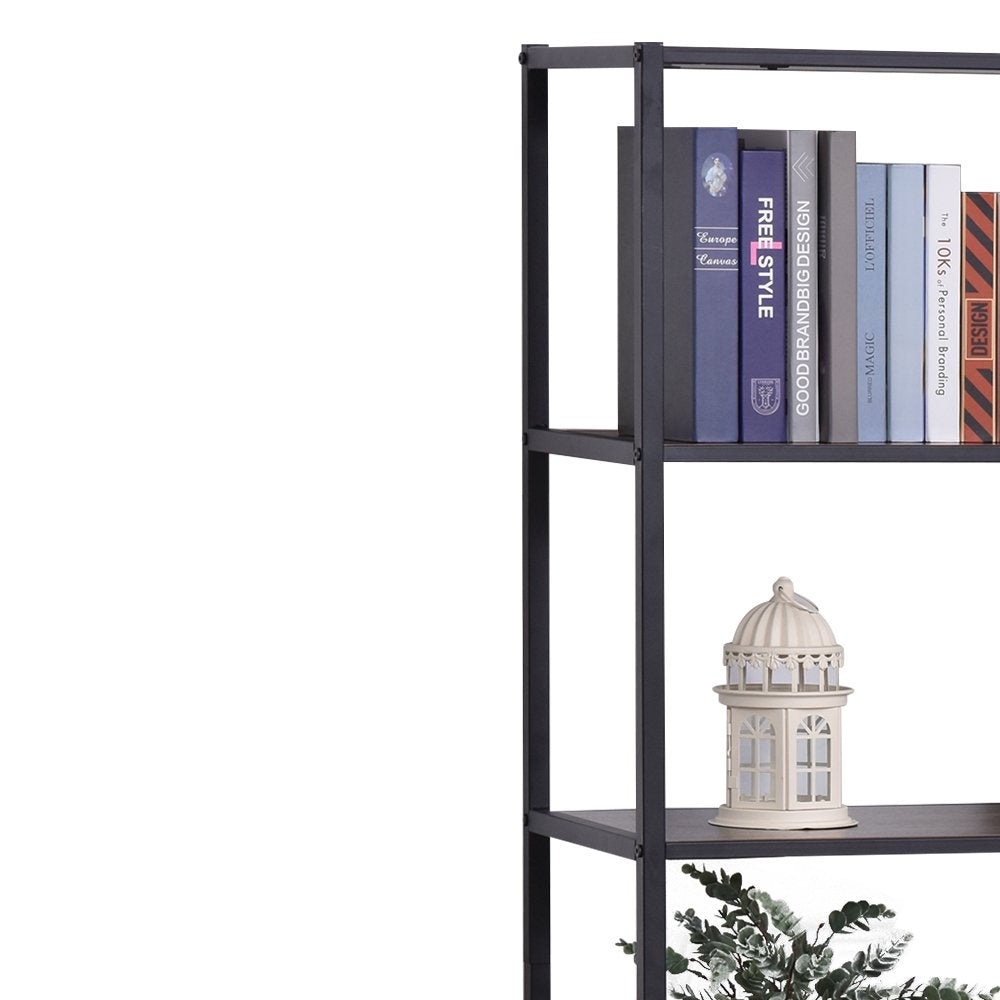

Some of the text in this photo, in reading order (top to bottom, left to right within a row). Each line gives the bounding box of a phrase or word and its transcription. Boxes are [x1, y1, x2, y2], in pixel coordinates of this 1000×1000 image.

[696, 231, 738, 246] Europe
[696, 254, 738, 266] Canvas
[758, 197, 774, 319] FREE STYLE
[864, 198, 875, 272] L'OFFICIEL
[935, 213, 951, 396] The 10Ks of Personal Branding
[971, 302, 988, 356] DESIGN
[865, 331, 875, 376] MAGIC
